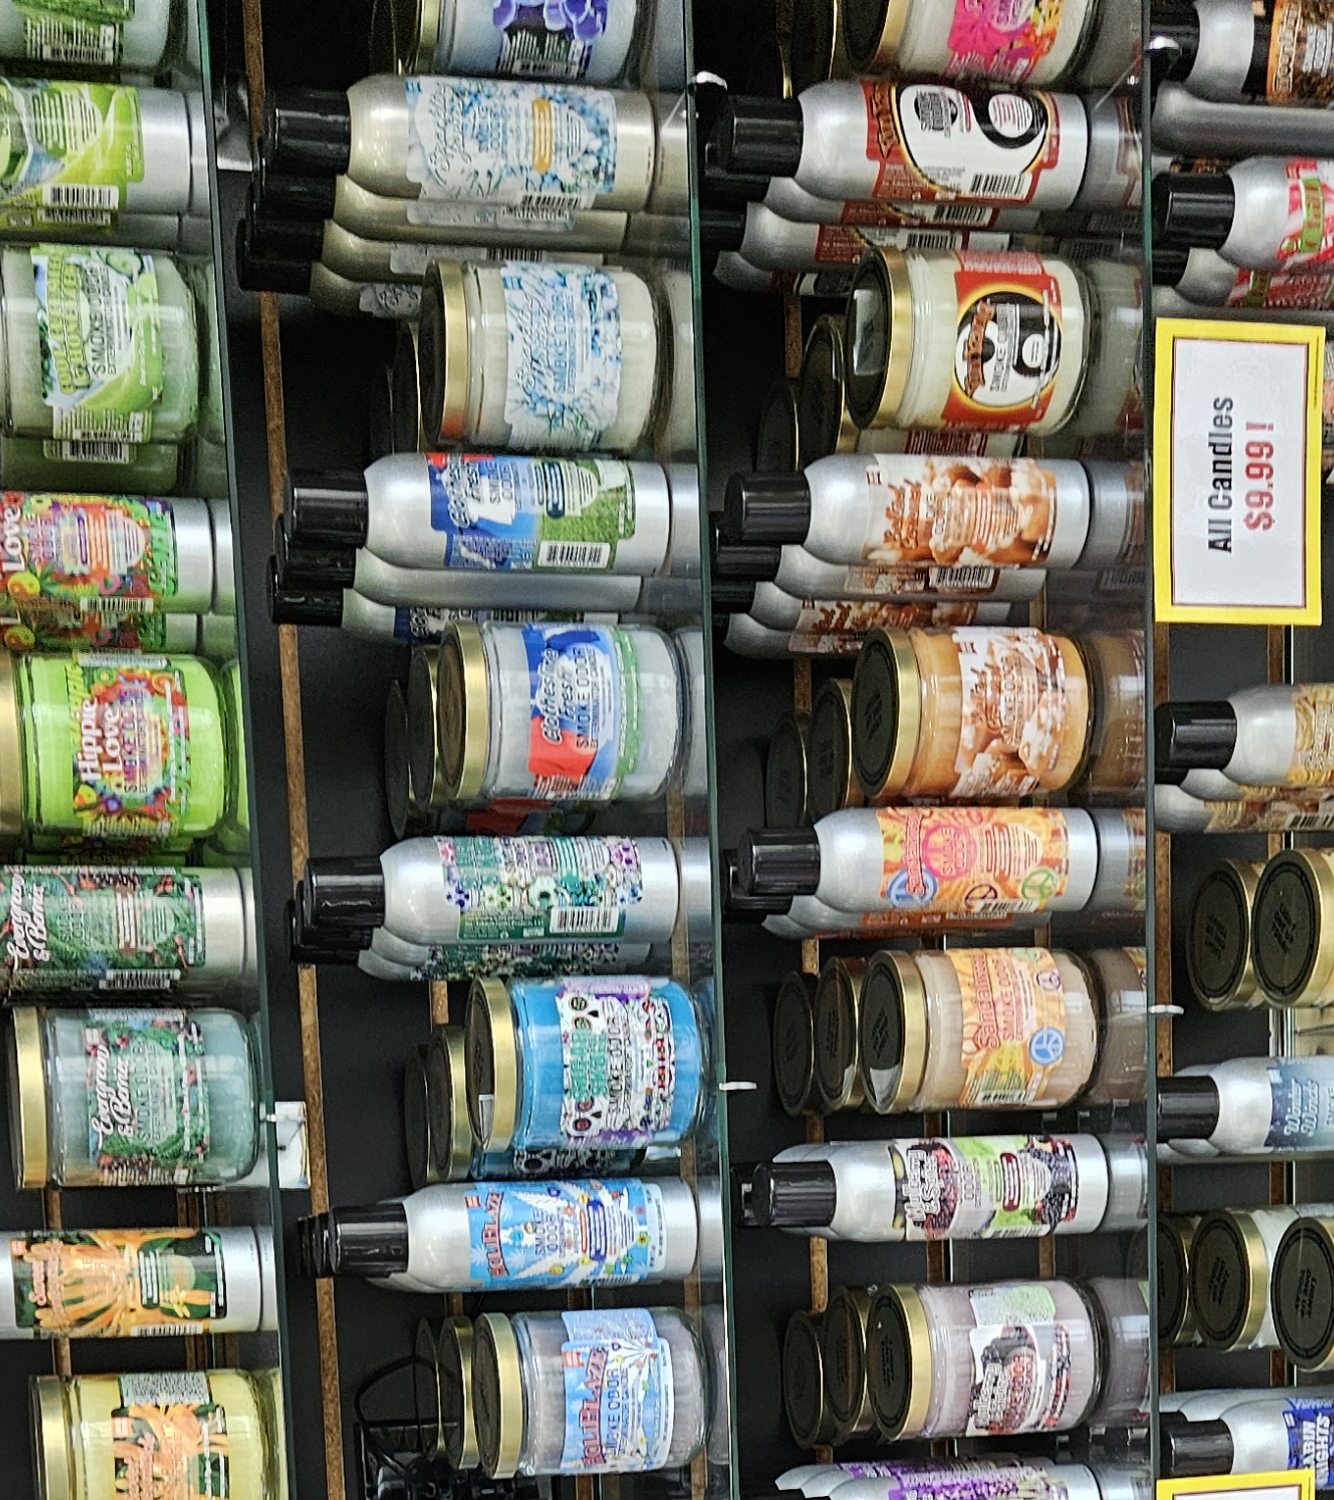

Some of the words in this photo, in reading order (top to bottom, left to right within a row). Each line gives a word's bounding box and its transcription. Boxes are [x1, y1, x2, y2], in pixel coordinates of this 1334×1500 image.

[1208, 397, 1233, 510] Candles
[1243, 441, 1275, 531] $9.99
[1, 505, 25, 571] Love
[1208, 518, 1232, 553] All
[77, 698, 104, 781] Hippie
[101, 708, 123, 771] Love
[576, 692, 590, 749] SMOKE
